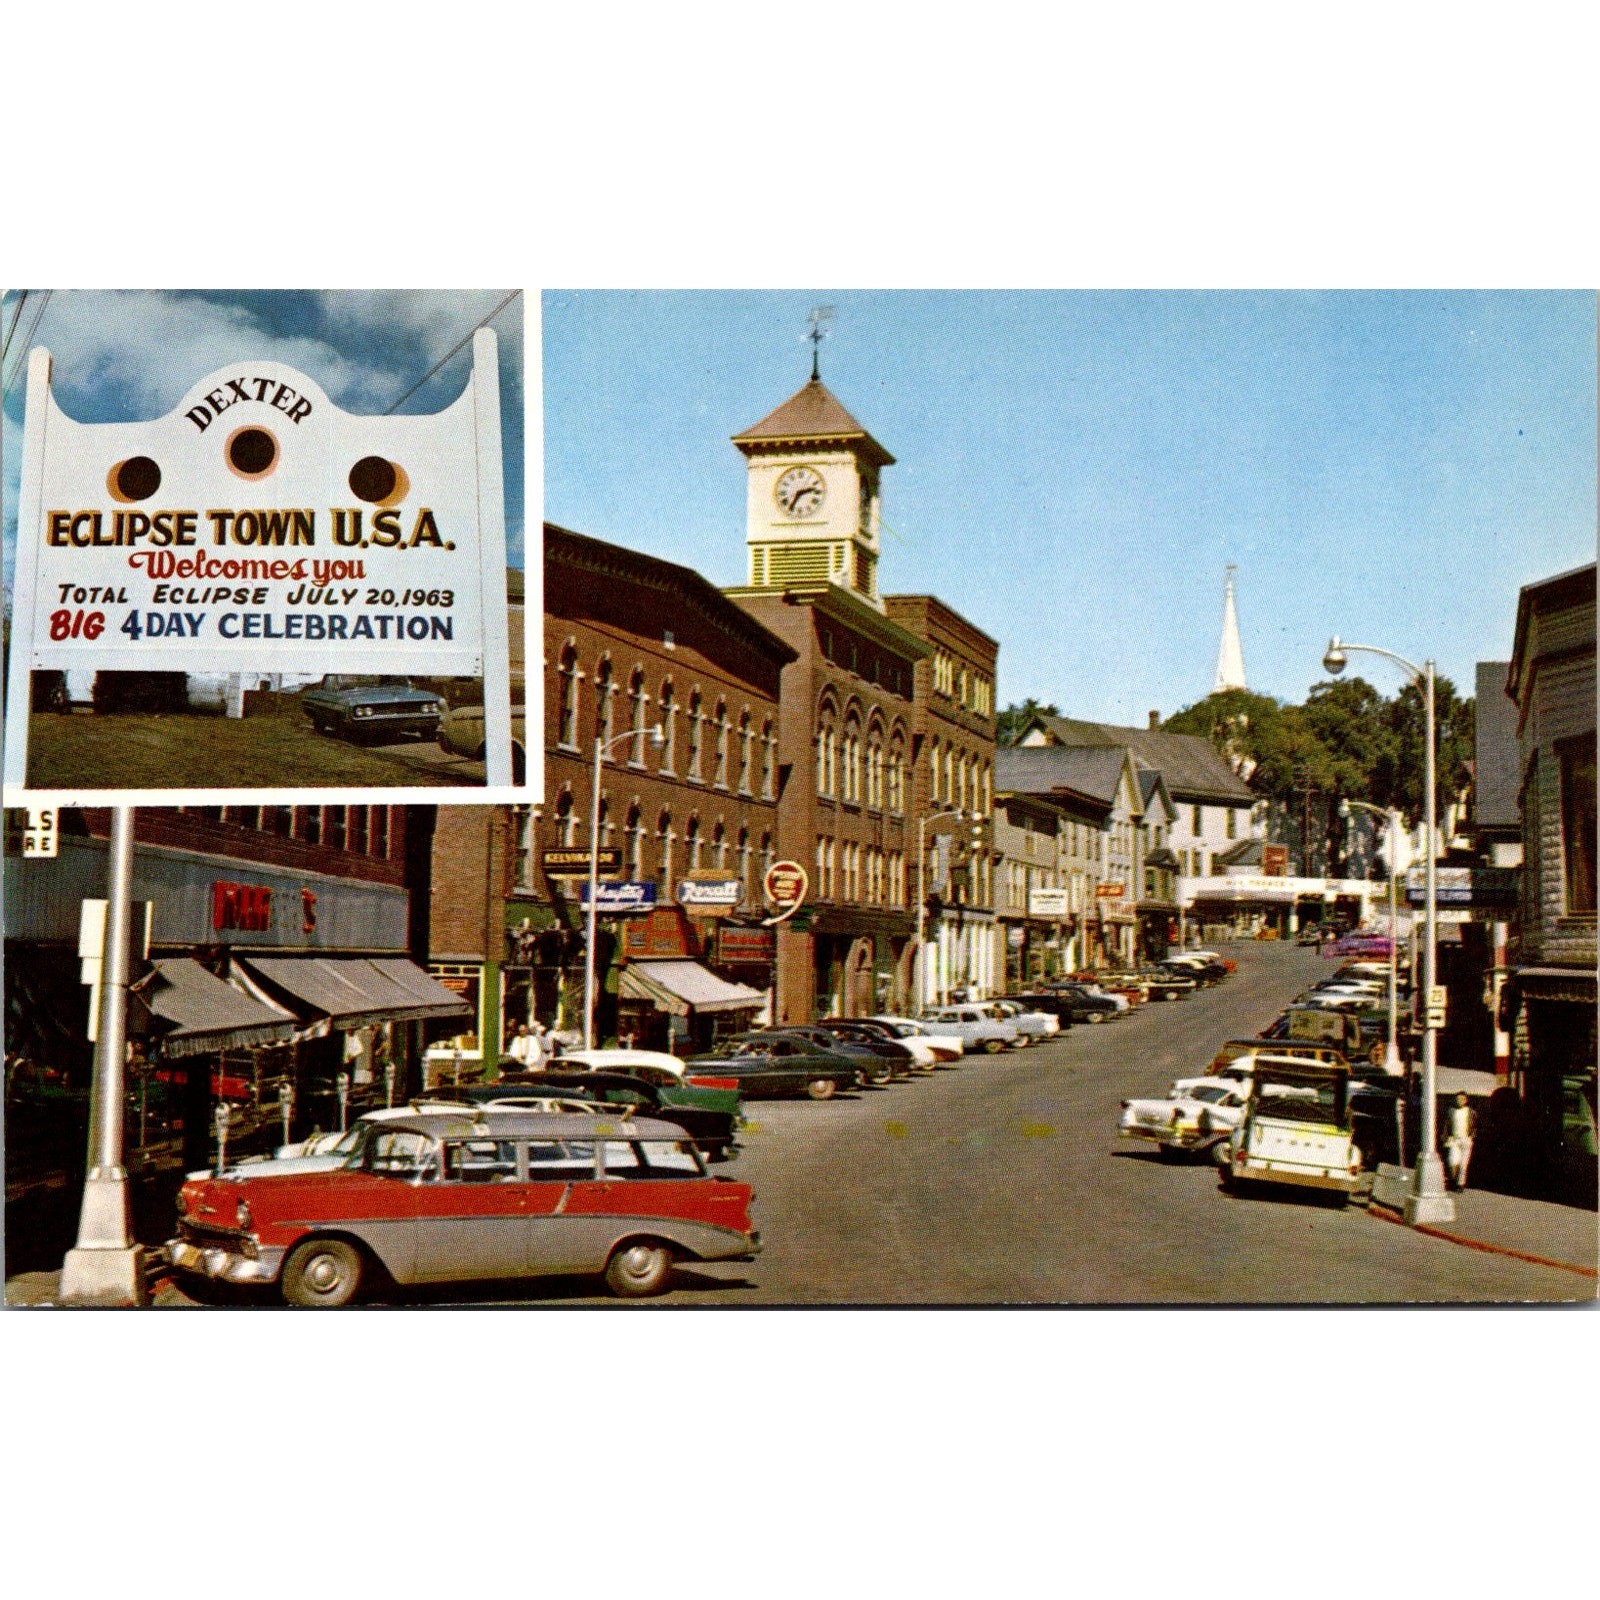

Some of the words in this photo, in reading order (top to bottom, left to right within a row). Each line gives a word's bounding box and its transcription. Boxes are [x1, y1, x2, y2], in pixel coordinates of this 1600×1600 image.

[186, 377, 313, 433] DEXTER
[47, 509, 199, 548] ECLIPSE
[206, 508, 316, 547] TOWN
[329, 508, 457, 551] U.S.A.
[128, 549, 309, 581] Welcomes
[310, 558, 367, 587] you
[58, 583, 129, 604] TOTAL
[152, 584, 270, 605] ECLIPSE
[286, 582, 358, 606] JULY
[49, 609, 106, 641] BIG
[217, 612, 453, 641] CELEBRATION
